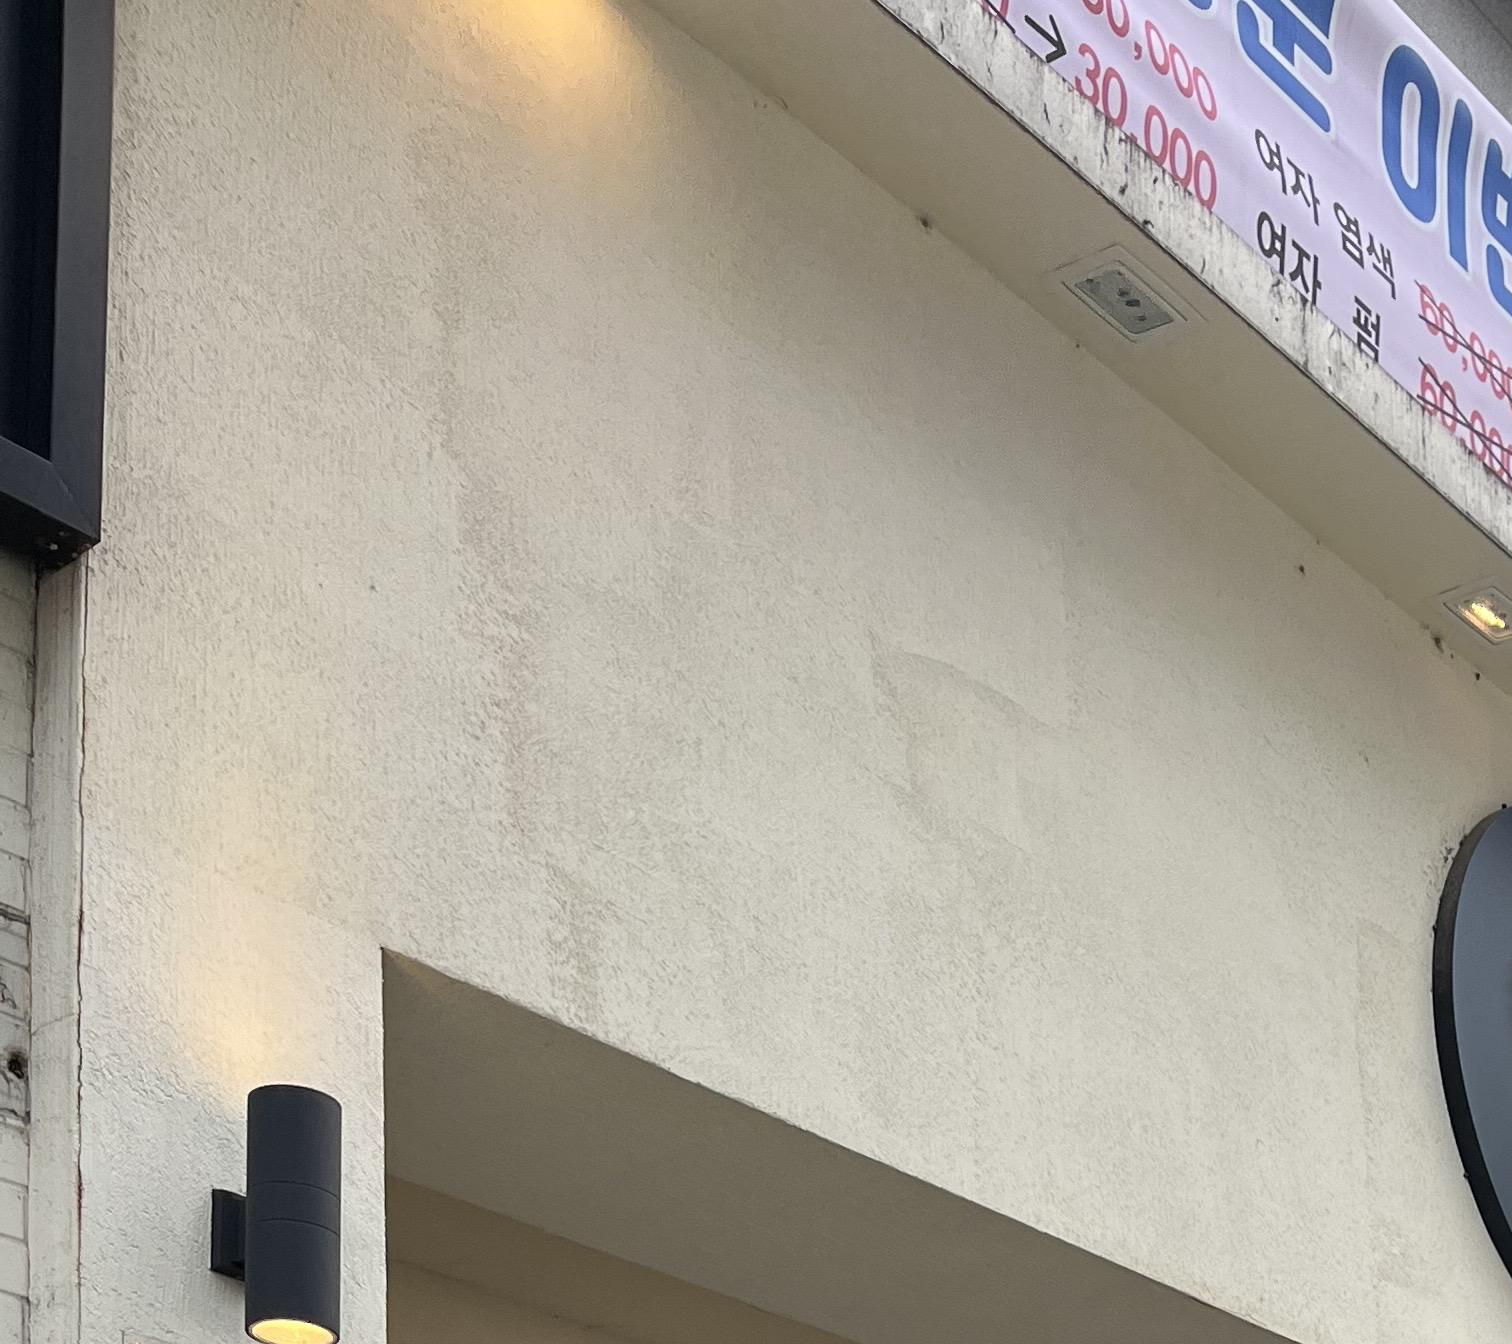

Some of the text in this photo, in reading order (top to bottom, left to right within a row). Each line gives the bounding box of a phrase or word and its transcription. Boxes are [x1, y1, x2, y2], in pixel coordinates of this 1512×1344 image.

[1083, 0, 1217, 121] 0,000
[1254, 129, 1320, 226] 여자
[1333, 201, 1397, 301] 염색
[1257, 211, 1322, 307] 여자
